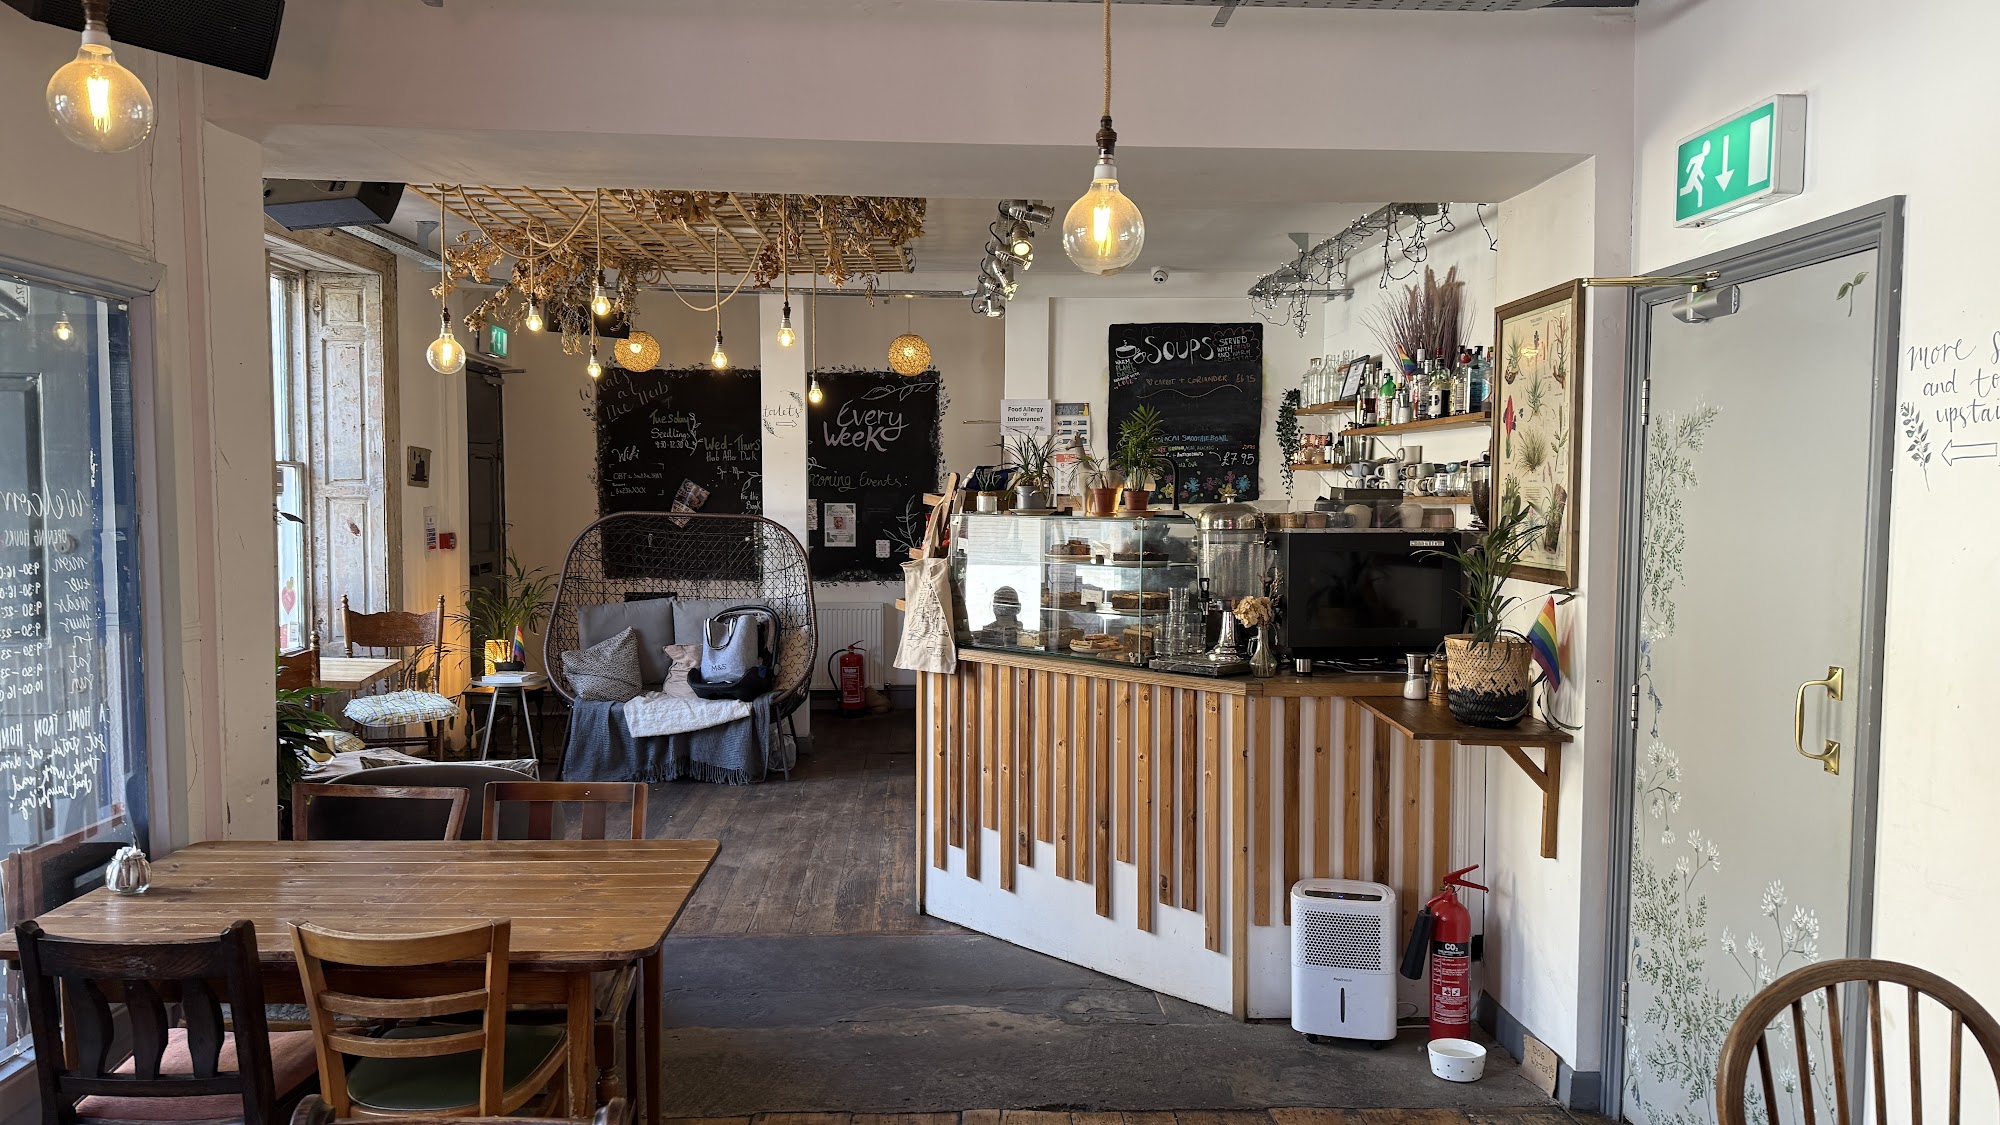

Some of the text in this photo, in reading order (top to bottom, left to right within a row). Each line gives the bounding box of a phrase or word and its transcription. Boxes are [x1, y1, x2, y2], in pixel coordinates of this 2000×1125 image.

[1218, 335, 1248, 347] SERVED
[1217, 345, 1233, 353] WITH
[1907, 338, 1977, 371] more
[1187, 374, 1228, 384] CORIANDER
[1923, 368, 1958, 397] and
[763, 404, 800, 418] toilets
[1023, 406, 1044, 414] Allergy
[649, 409, 691, 429] Tuesday
[650, 427, 691, 442] Seedlings
[740, 450, 758, 461] Dark
